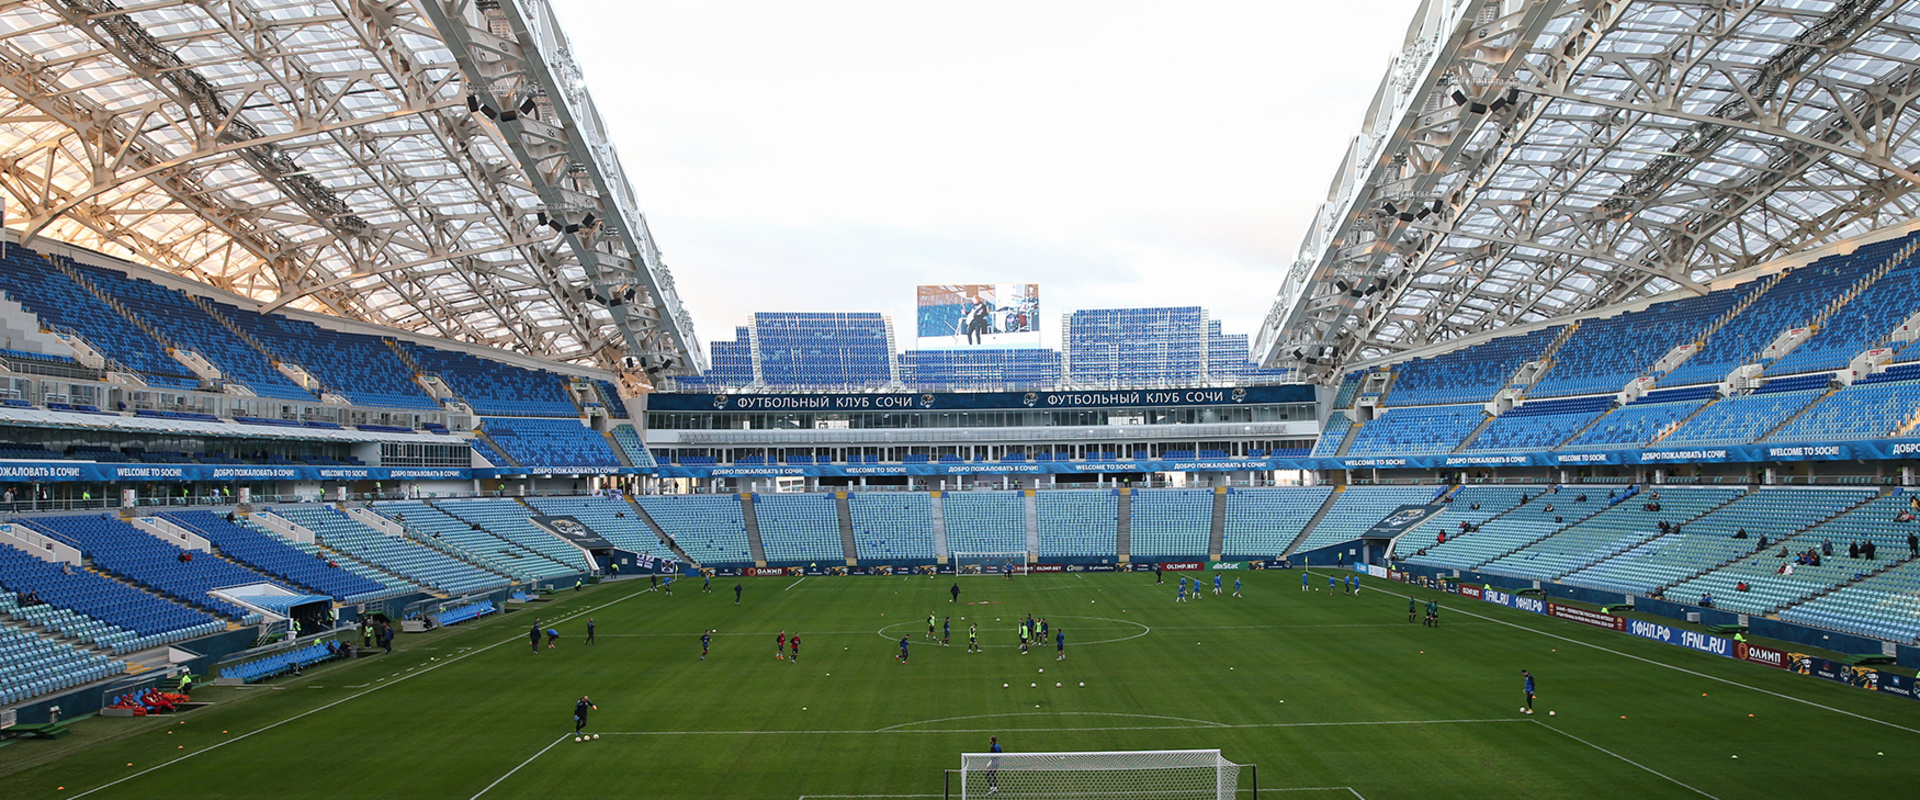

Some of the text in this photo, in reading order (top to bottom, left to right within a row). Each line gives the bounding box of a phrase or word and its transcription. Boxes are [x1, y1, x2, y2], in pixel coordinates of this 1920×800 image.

[737, 395, 913, 408] ФУТБОЛЬНЫЙ КЛУБ СОЧИ
[1047, 391, 1223, 405] ФУТБОЛЬНЫЙ КЛУБ СОЧИ
[1641, 452, 1660, 461] ДОБРО
[1769, 447, 1803, 456] WELCOME
[1804, 447, 1814, 455] TO
[50, 467, 55, 476] В
[56, 467, 80, 477] СОЧИ!
[116, 468, 150, 477] WELCOME
[151, 468, 160, 477] TO
[213, 468, 234, 478] ДОБРО
[390, 470, 406, 478] ДОБРО
[1632, 620, 1671, 642] 1ФНЛ.РФ
[1681, 630, 1726, 654] 1FNL.RU
[1749, 647, 1781, 663] ОЛИМП
